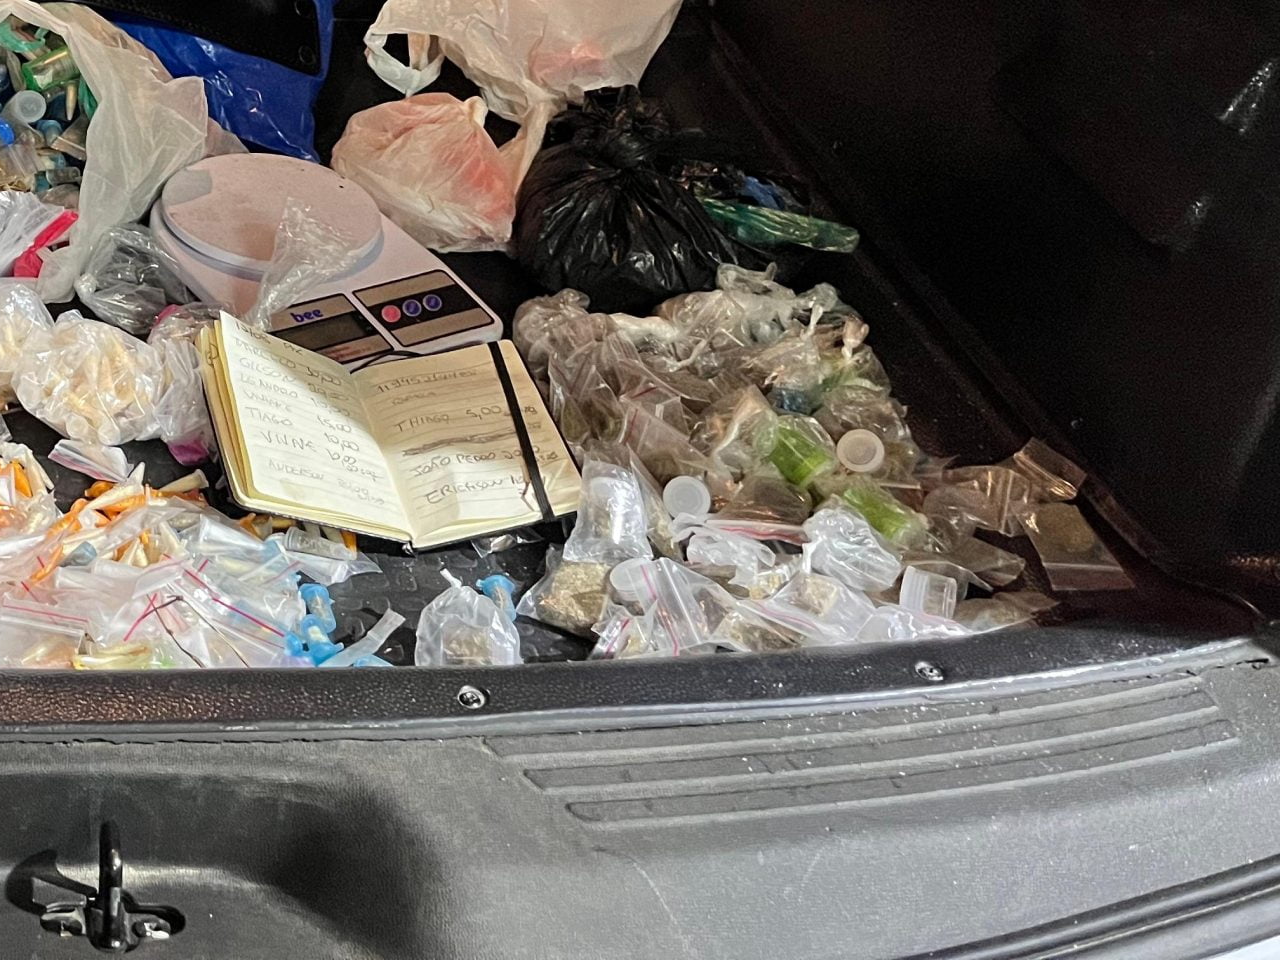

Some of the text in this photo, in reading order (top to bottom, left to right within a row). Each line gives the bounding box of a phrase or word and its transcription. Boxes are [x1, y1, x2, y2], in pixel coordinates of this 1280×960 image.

[290, 308, 324, 323] bee
[244, 406, 293, 426] TIAGO
[465, 405, 502, 420] 5,00
